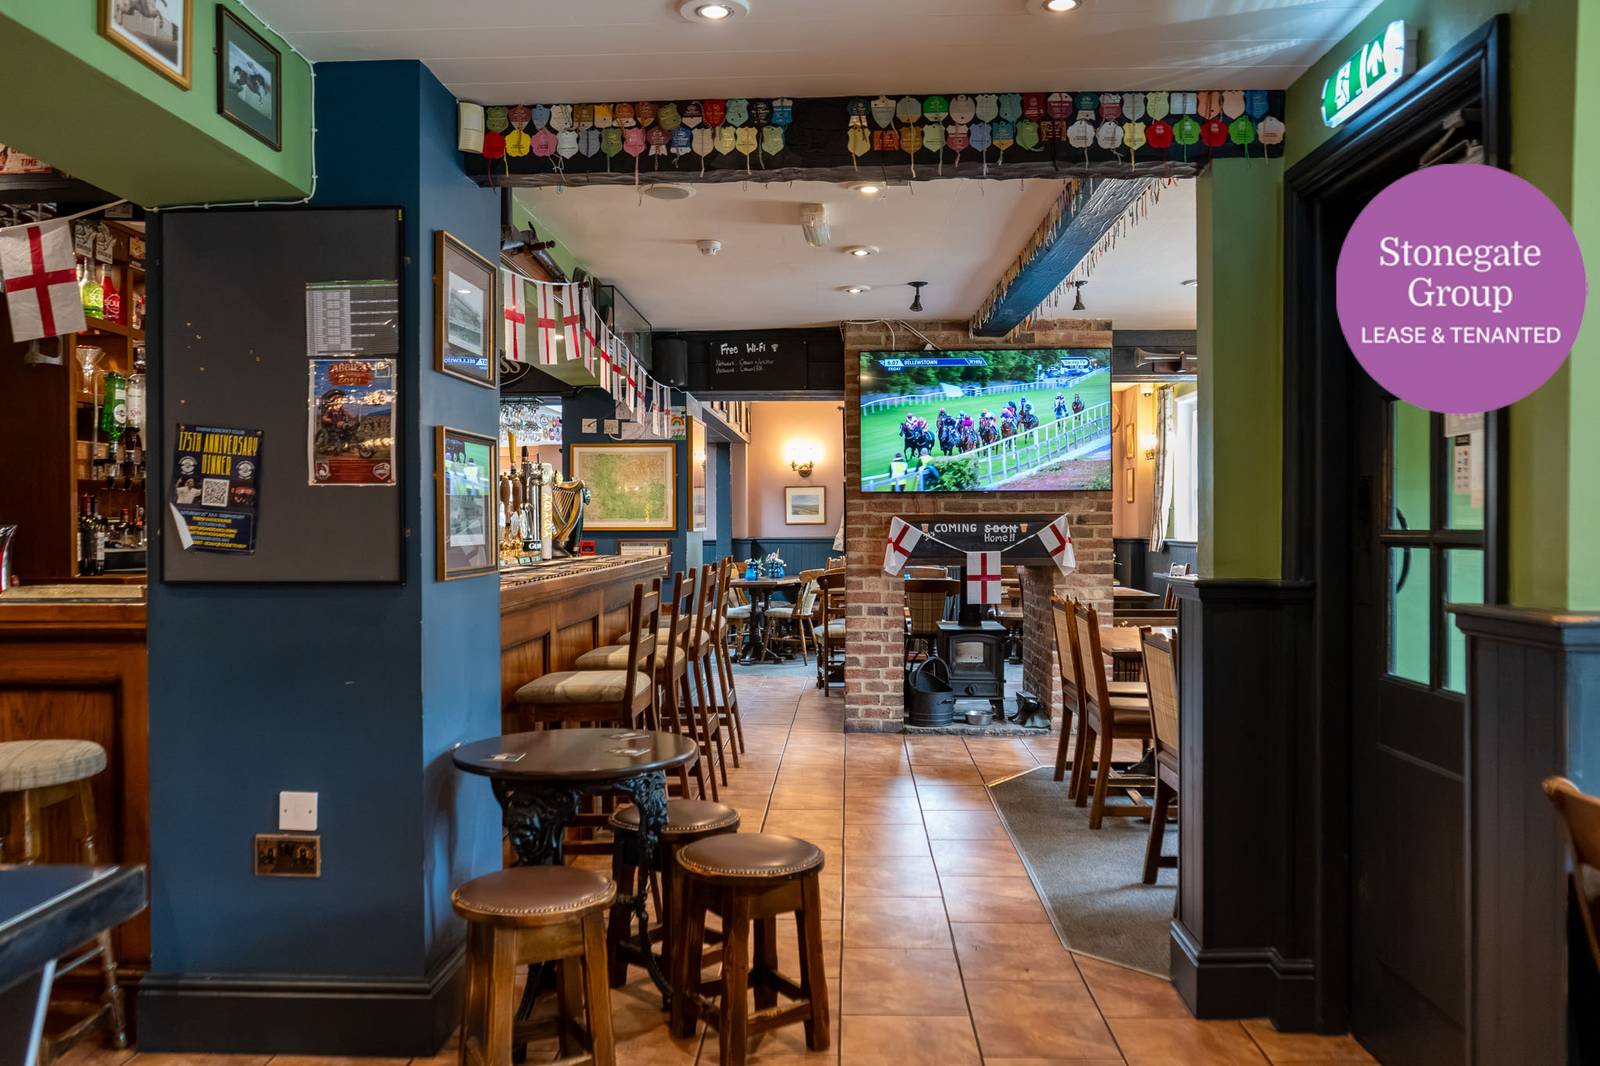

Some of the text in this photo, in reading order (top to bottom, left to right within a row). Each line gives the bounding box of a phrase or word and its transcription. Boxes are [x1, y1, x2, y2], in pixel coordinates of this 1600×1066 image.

[720, 343, 738, 355] Free
[178, 431, 259, 457] 175TH ANNIVERSARY
[201, 453, 232, 476] DINNER
[934, 523, 977, 533] COMING
